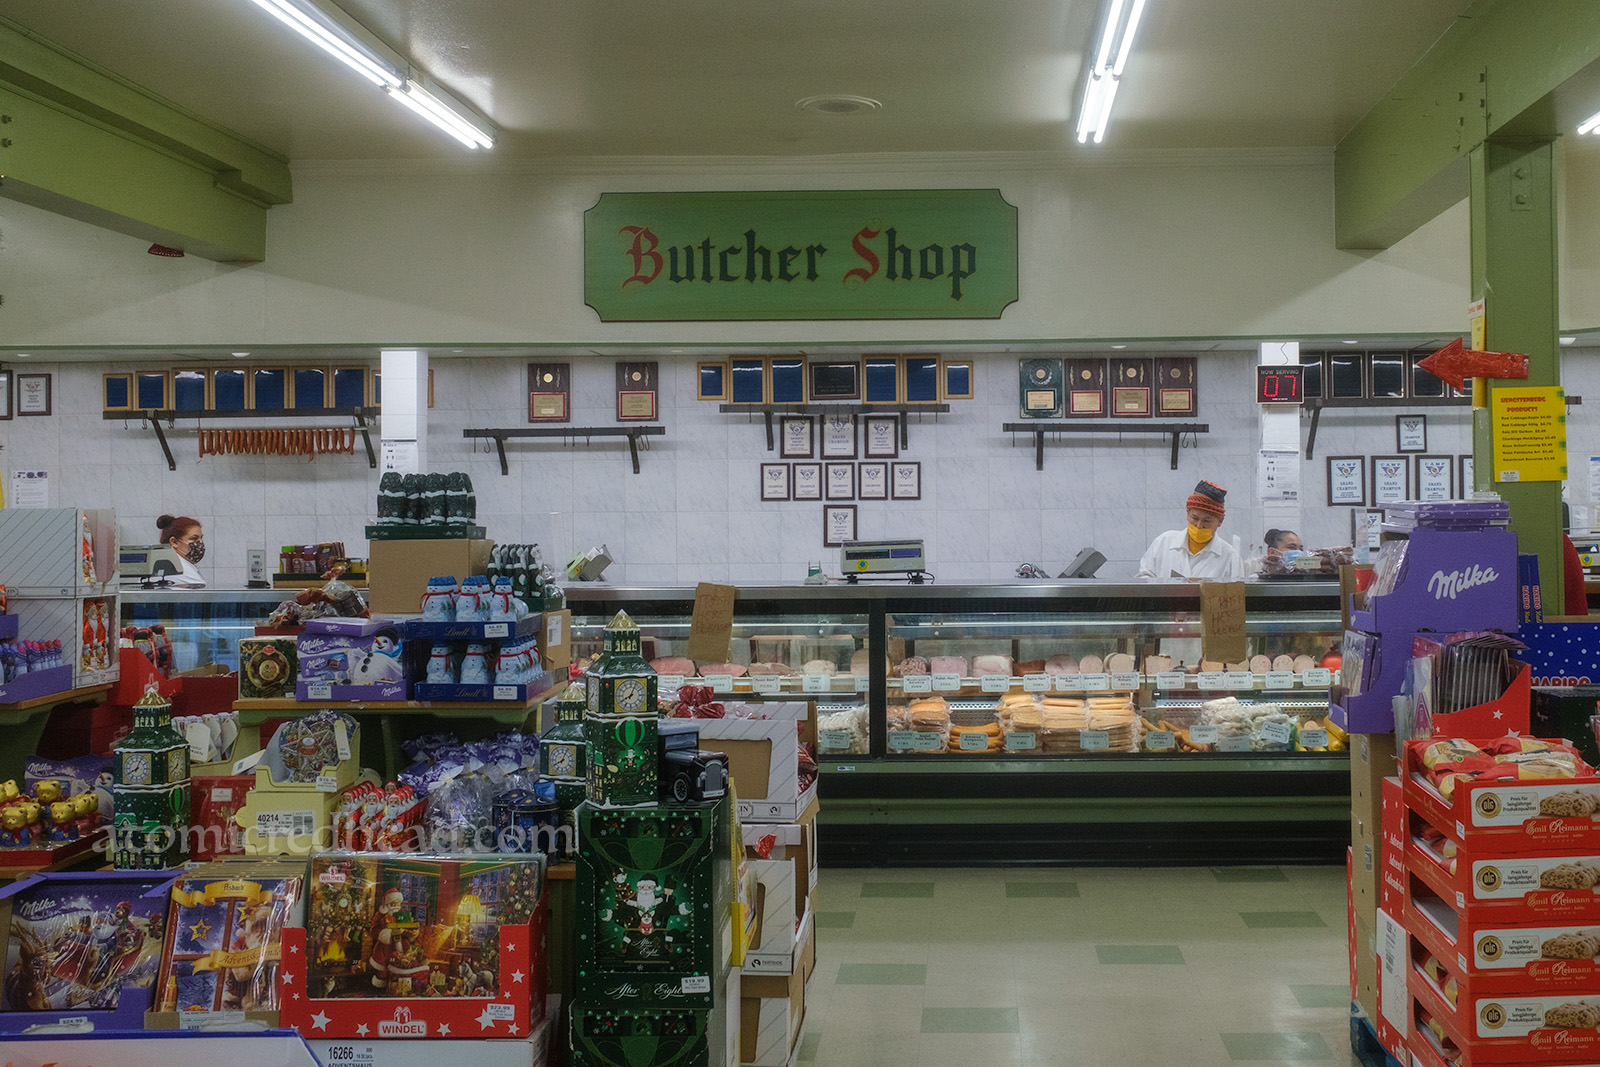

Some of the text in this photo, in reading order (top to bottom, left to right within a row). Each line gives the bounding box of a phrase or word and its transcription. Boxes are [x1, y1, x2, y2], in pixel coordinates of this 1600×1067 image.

[618, 217, 977, 300] Butcher Shop
[1264, 375, 1296, 397] 07
[1427, 563, 1499, 600] Milka
[1522, 585, 1530, 610] HARIBO
[1533, 585, 1541, 610] HARIBO
[697, 610, 727, 622] HERE
[1212, 610, 1239, 625] HERE
[444, 626, 471, 637] Lindt
[300, 638, 325, 652] Milka
[306, 658, 325, 669] Milka
[381, 686, 402, 697] Milka
[455, 687, 481, 697] Lindt
[1526, 819, 1589, 835] Emil Reimann
[224, 883, 245, 891] Asbach
[20, 897, 57, 916] Milka
[1527, 892, 1590, 907] Emil Reimann
[631, 937, 654, 951] After
[640, 947, 660, 958] Eight
[1529, 961, 1591, 977] Emil Reimann
[604, 982, 685, 1000] After Eight
[382, 1025, 424, 1034] WINDEL
[1531, 1030, 1594, 1046] Emil Reimann
[327, 1046, 354, 1060] 16266
